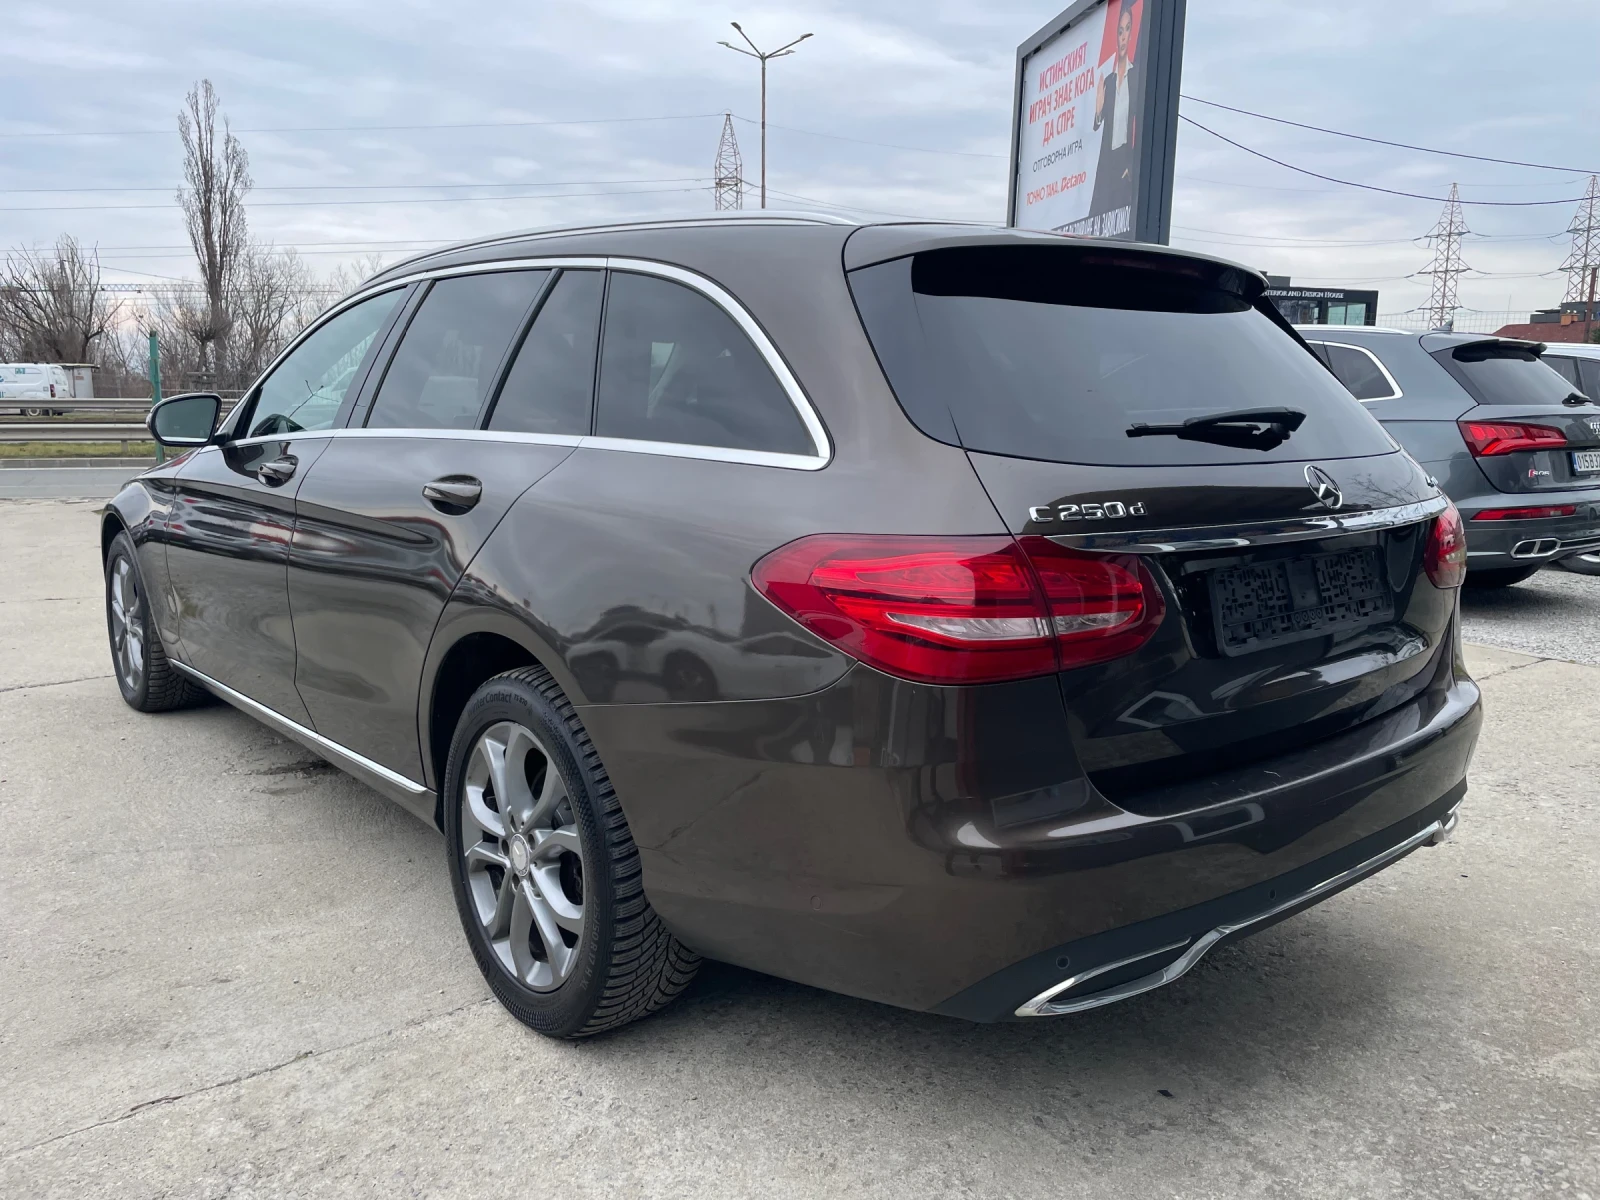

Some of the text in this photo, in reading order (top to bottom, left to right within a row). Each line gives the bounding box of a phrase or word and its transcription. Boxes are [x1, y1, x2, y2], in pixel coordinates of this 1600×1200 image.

[1039, 42, 1088, 93] ИСТИНСКИЯТ
[1029, 66, 1095, 125] ИГРАЧ ЗНАЕ КОГА
[1042, 106, 1075, 147] ДА СПРЕ
[1032, 138, 1083, 173] ОТГОВОРНА ИГРА
[1026, 186, 1046, 206] ТОЧНО
[1060, 171, 1087, 193] Betano
[1302, 290, 1324, 298] DESIGN
[1324, 291, 1345, 299] HOUSE
[1028, 501, 1148, 523] C 250 d
